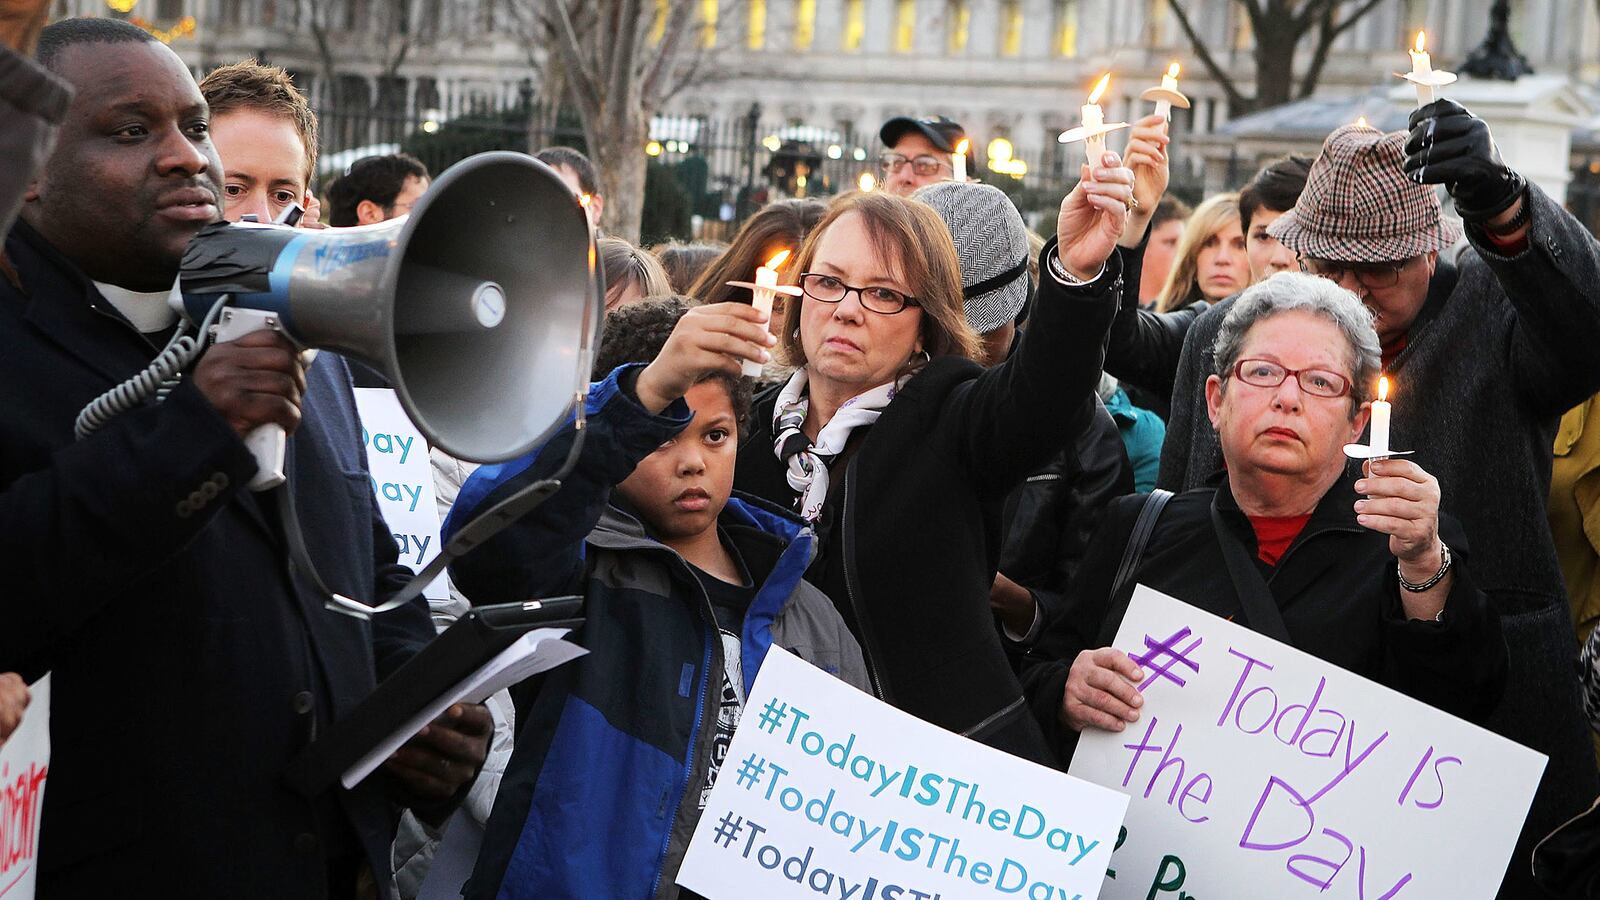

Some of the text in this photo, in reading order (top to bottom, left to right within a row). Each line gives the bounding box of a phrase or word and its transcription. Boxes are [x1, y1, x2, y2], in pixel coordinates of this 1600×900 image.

[362, 426, 414, 464] ay
[370, 476, 422, 512] ay
[757, 697, 1100, 865] #TodayISTheDay
[1123, 717, 1213, 823] the
[1239, 776, 1412, 900] Day
[1146, 855, 1195, 900] P
